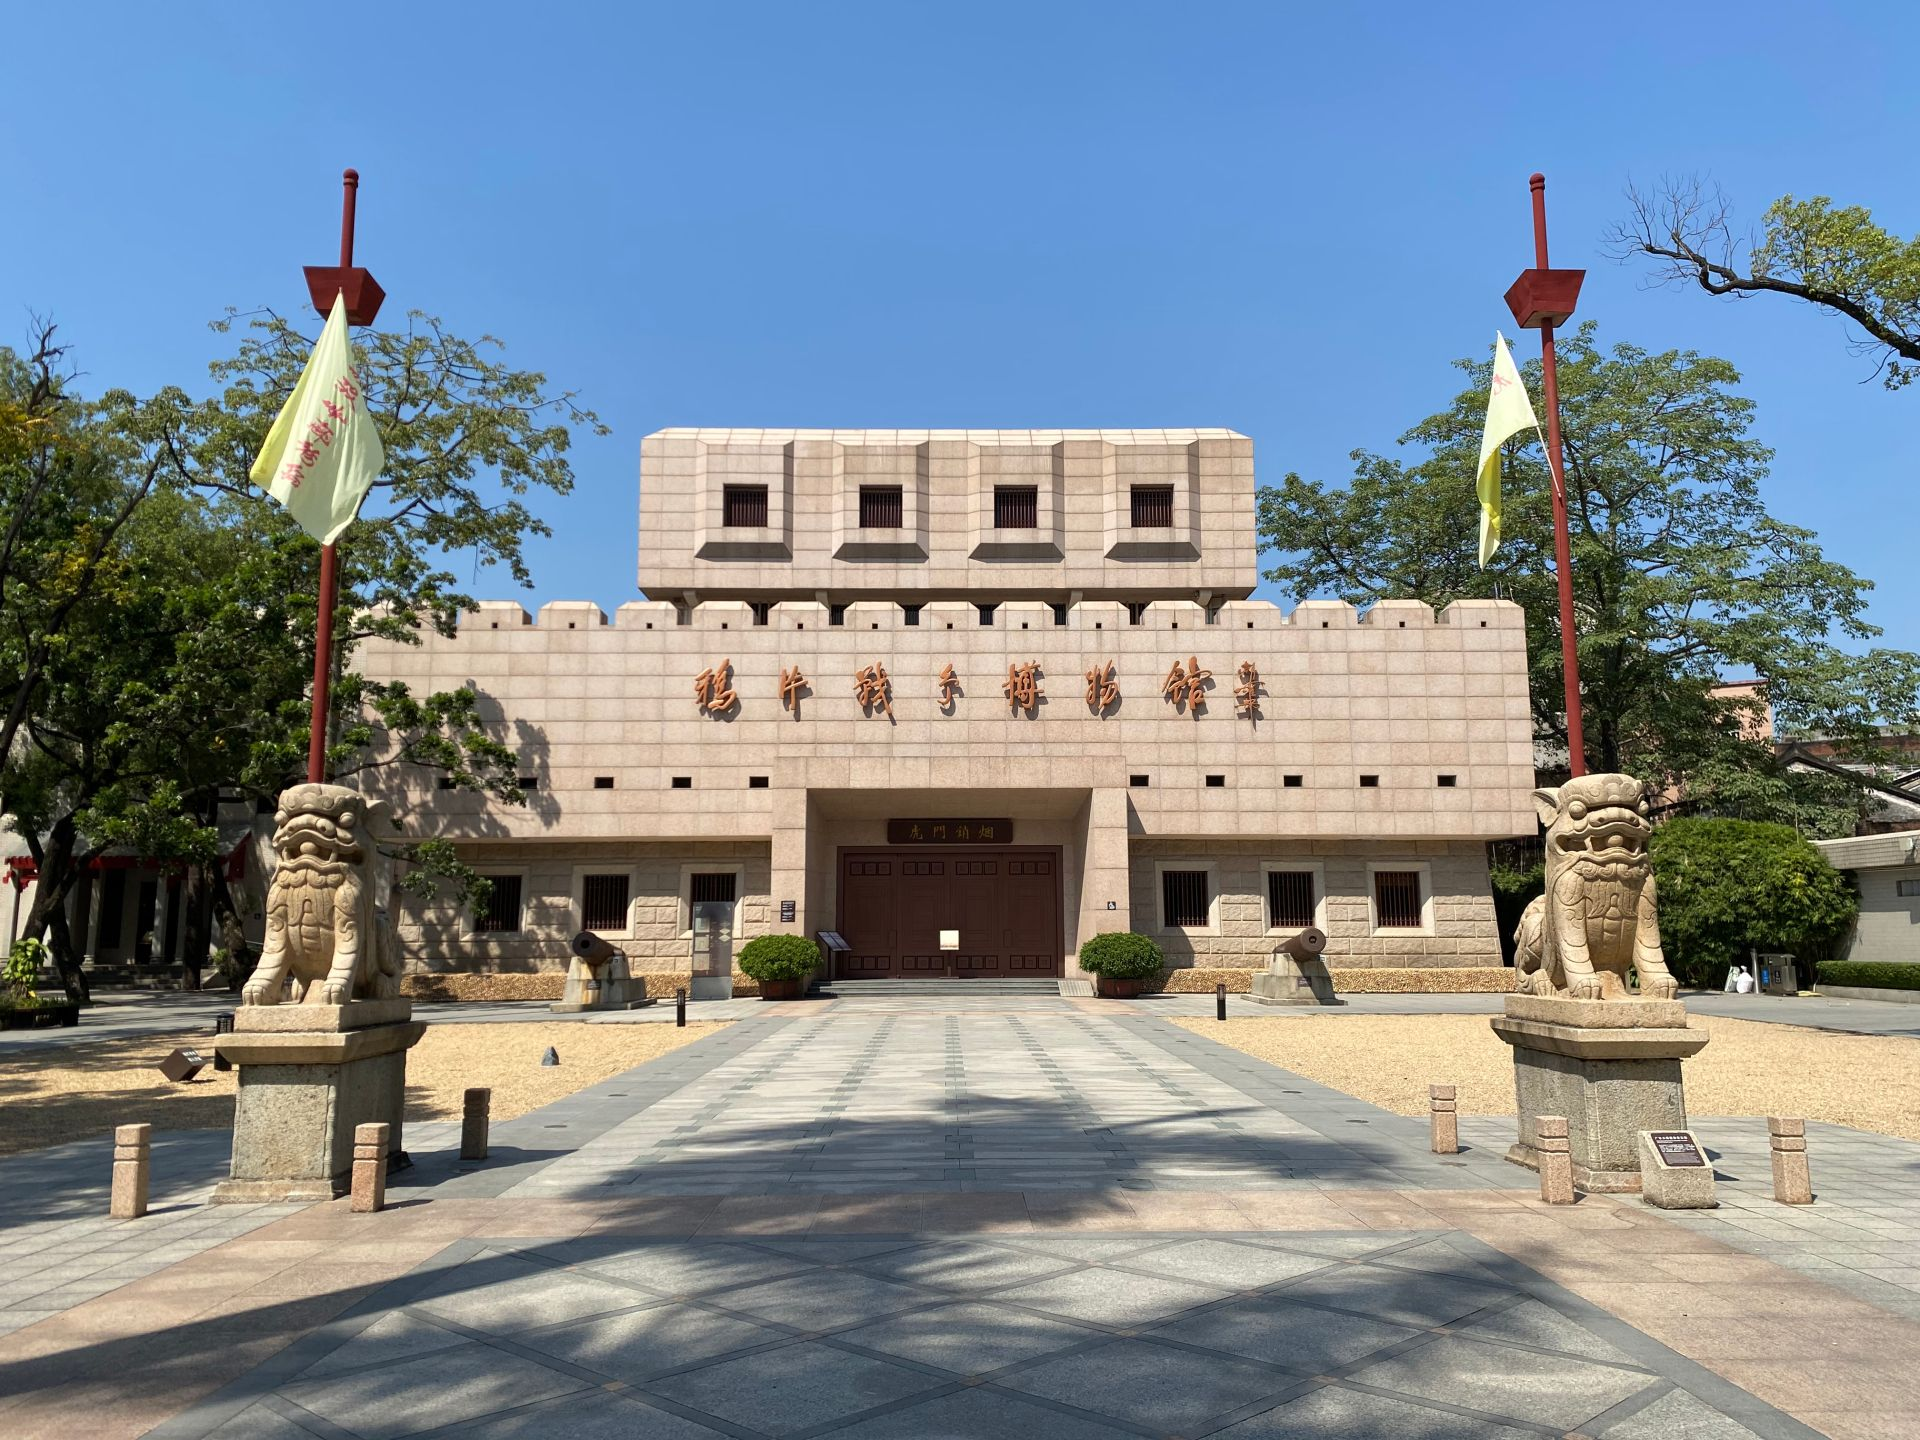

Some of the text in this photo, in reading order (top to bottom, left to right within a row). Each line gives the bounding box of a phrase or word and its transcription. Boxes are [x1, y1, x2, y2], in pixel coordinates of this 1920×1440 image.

[695, 656, 1212, 714] 鸦片战争博物馆
